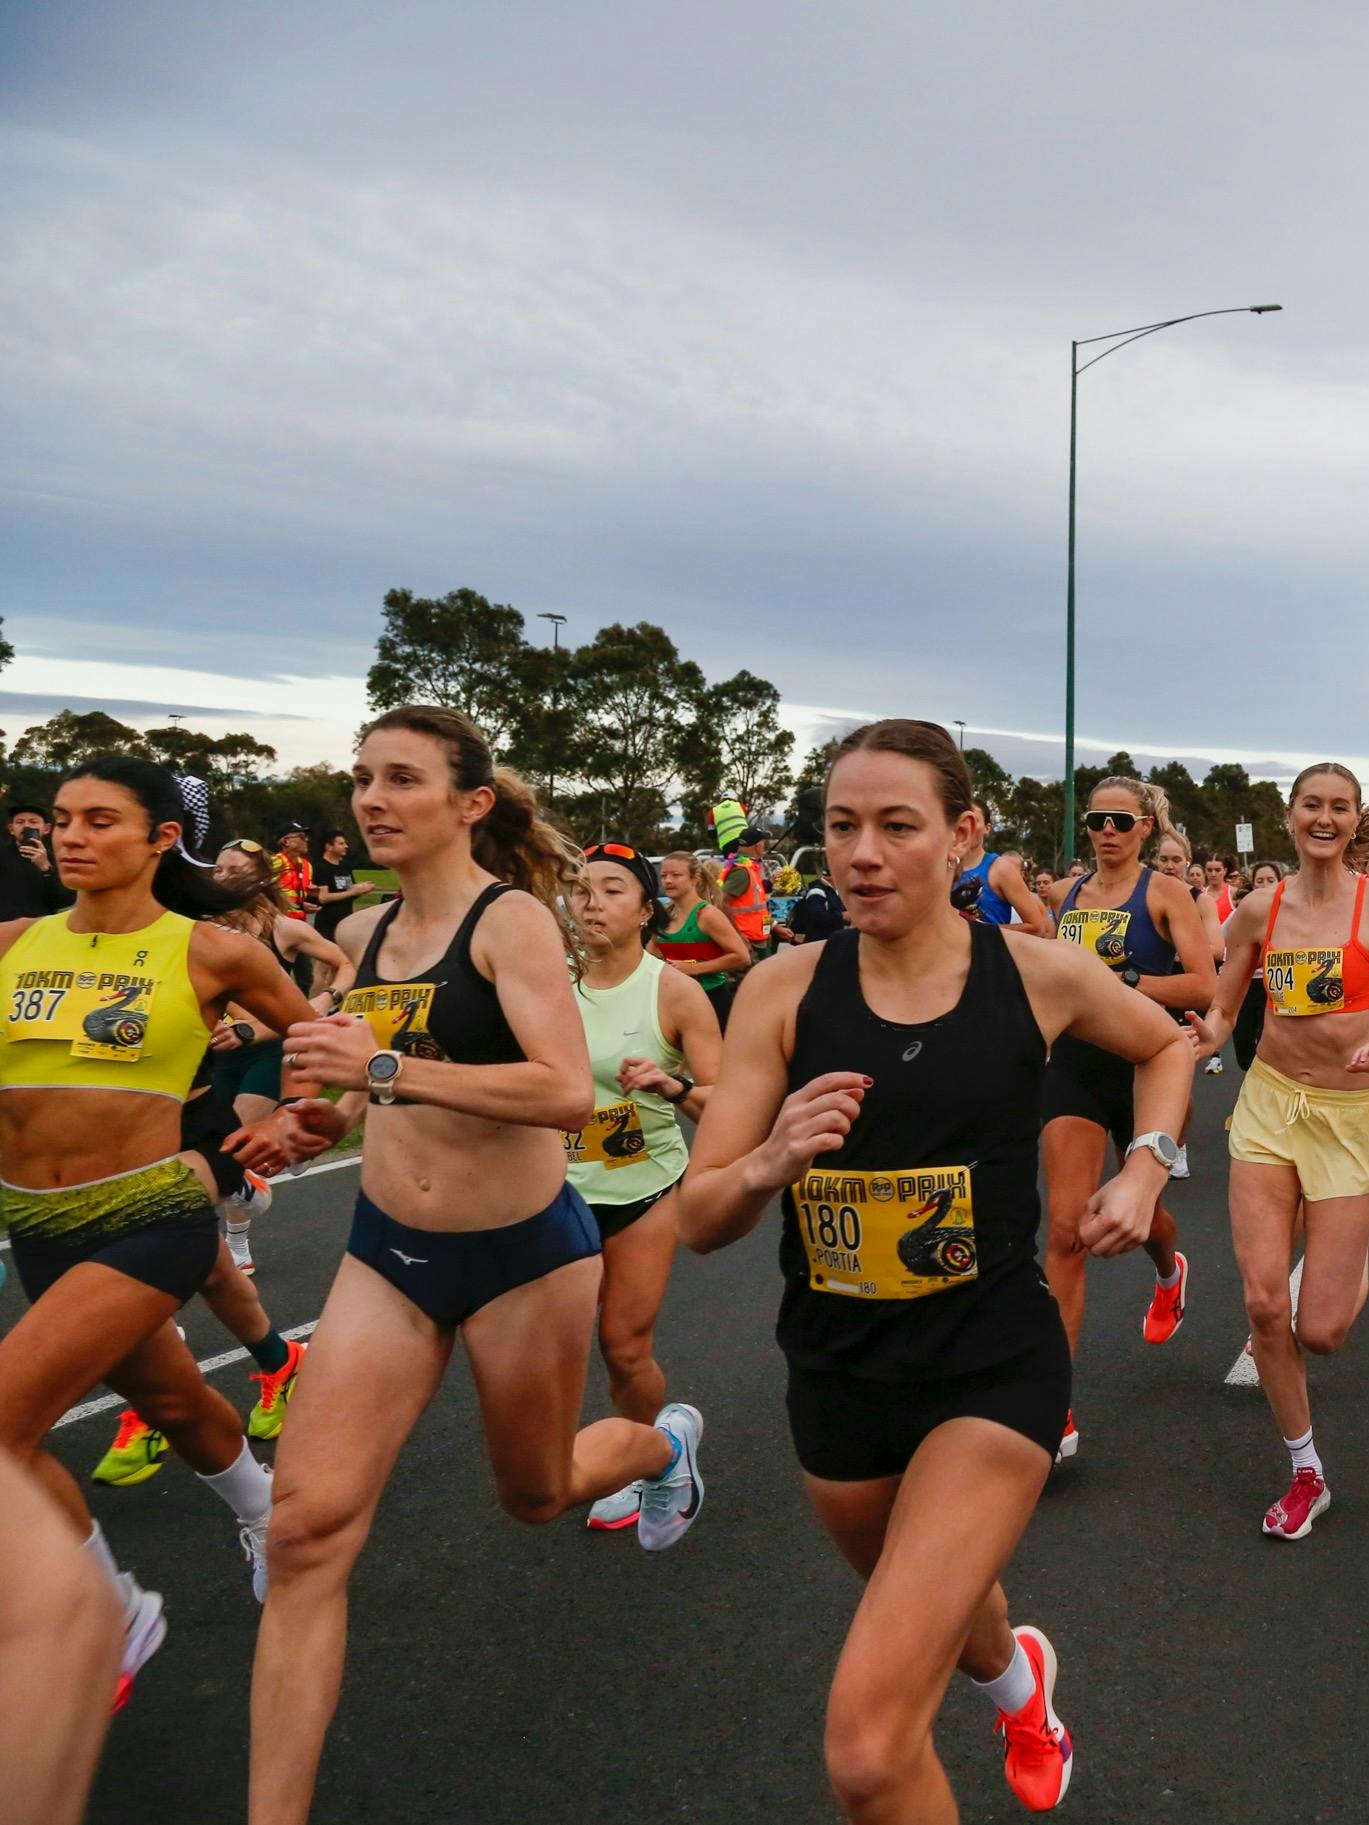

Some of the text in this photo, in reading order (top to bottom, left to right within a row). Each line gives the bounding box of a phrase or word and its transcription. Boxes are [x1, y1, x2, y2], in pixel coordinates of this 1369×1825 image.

[1267, 952, 1295, 967] 10KM
[16, 970, 75, 990] 10KM
[98, 973, 154, 995] PRIX
[1267, 967, 1293, 991] 204
[9, 989, 66, 1022] 387
[897, 1172, 966, 1203] PRIX
[800, 1203, 861, 1251] 180
[816, 1248, 862, 1273] PORTIA
